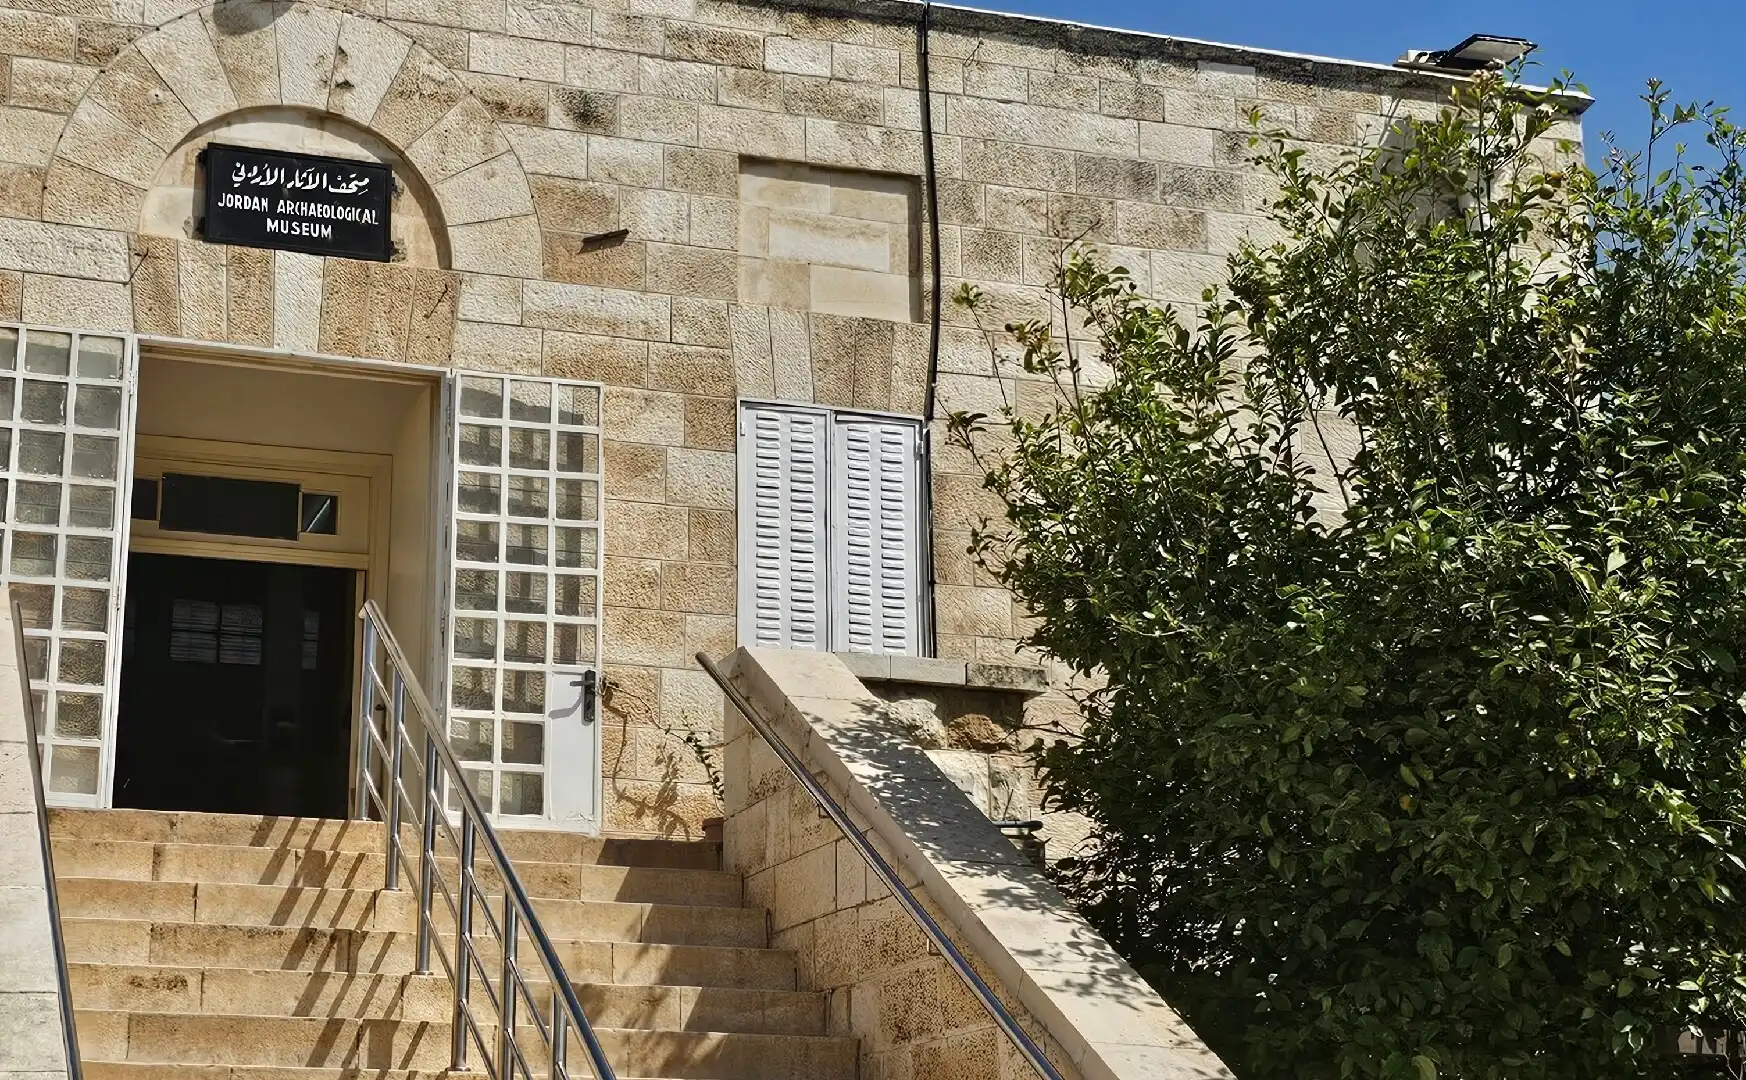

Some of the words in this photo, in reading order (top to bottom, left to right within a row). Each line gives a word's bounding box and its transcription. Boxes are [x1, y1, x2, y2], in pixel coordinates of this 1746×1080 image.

[217, 193, 269, 212] JORDAN
[277, 199, 379, 225] ARCHAEOLOGICAL
[266, 218, 332, 239] MUSEUM
